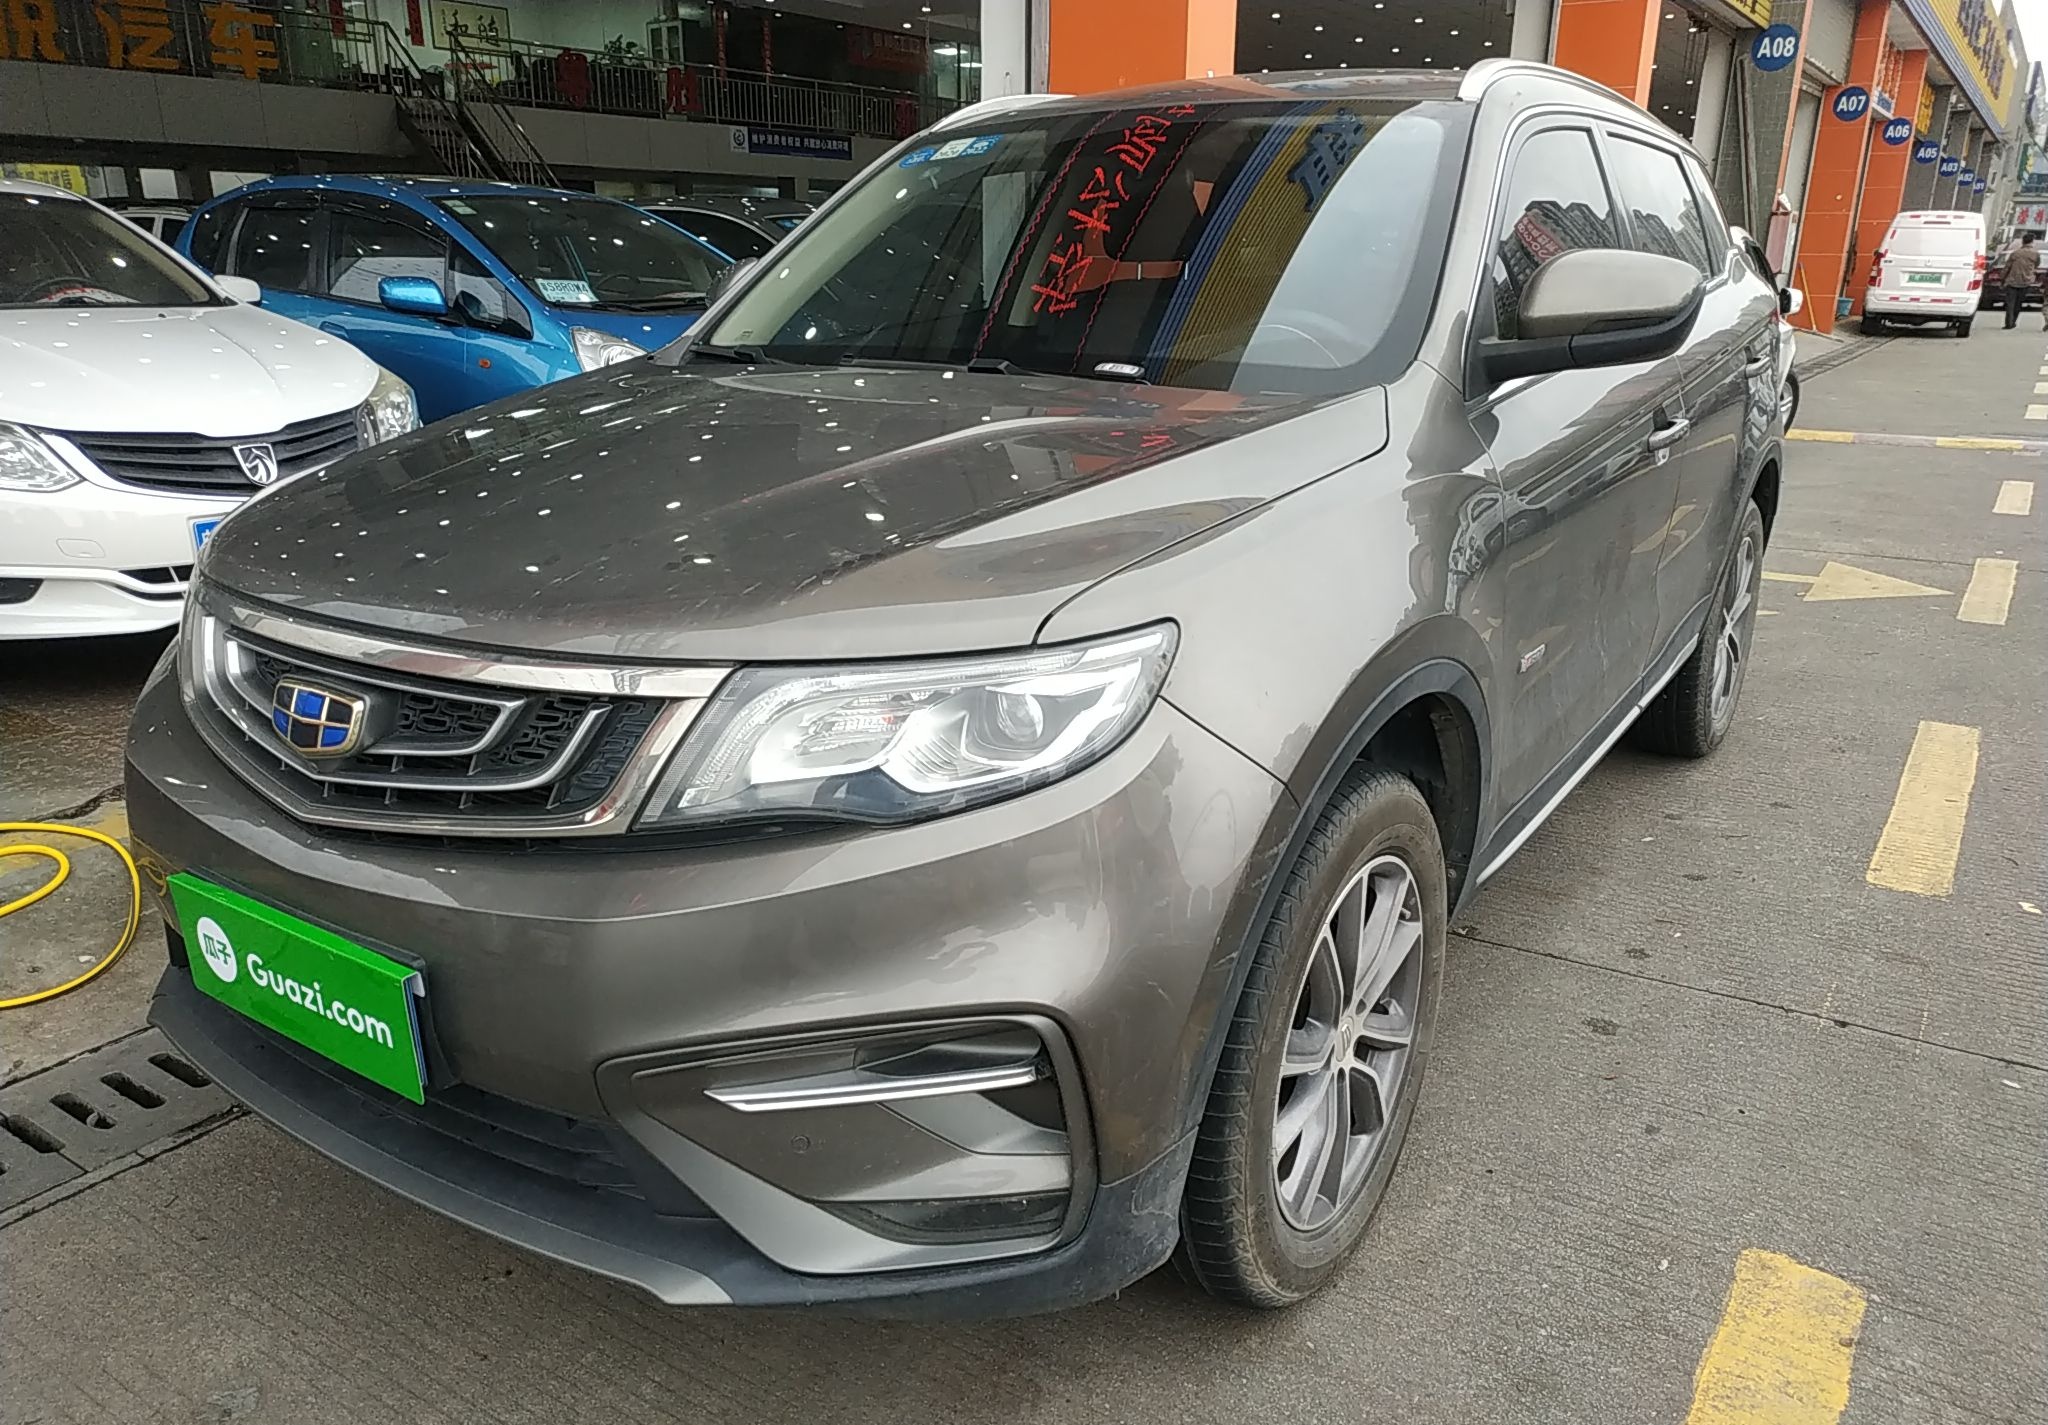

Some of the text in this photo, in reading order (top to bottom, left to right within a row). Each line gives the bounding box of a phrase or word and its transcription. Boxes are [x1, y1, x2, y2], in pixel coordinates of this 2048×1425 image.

[1757, 36, 1796, 59] A08
[1836, 95, 1867, 112] A07
[1885, 124, 1910, 138] A06
[1917, 147, 1938, 159] A05
[1941, 162, 1959, 172] A03
[202, 932, 232, 966] 瓜子
[246, 953, 394, 1049] Guazi.com
